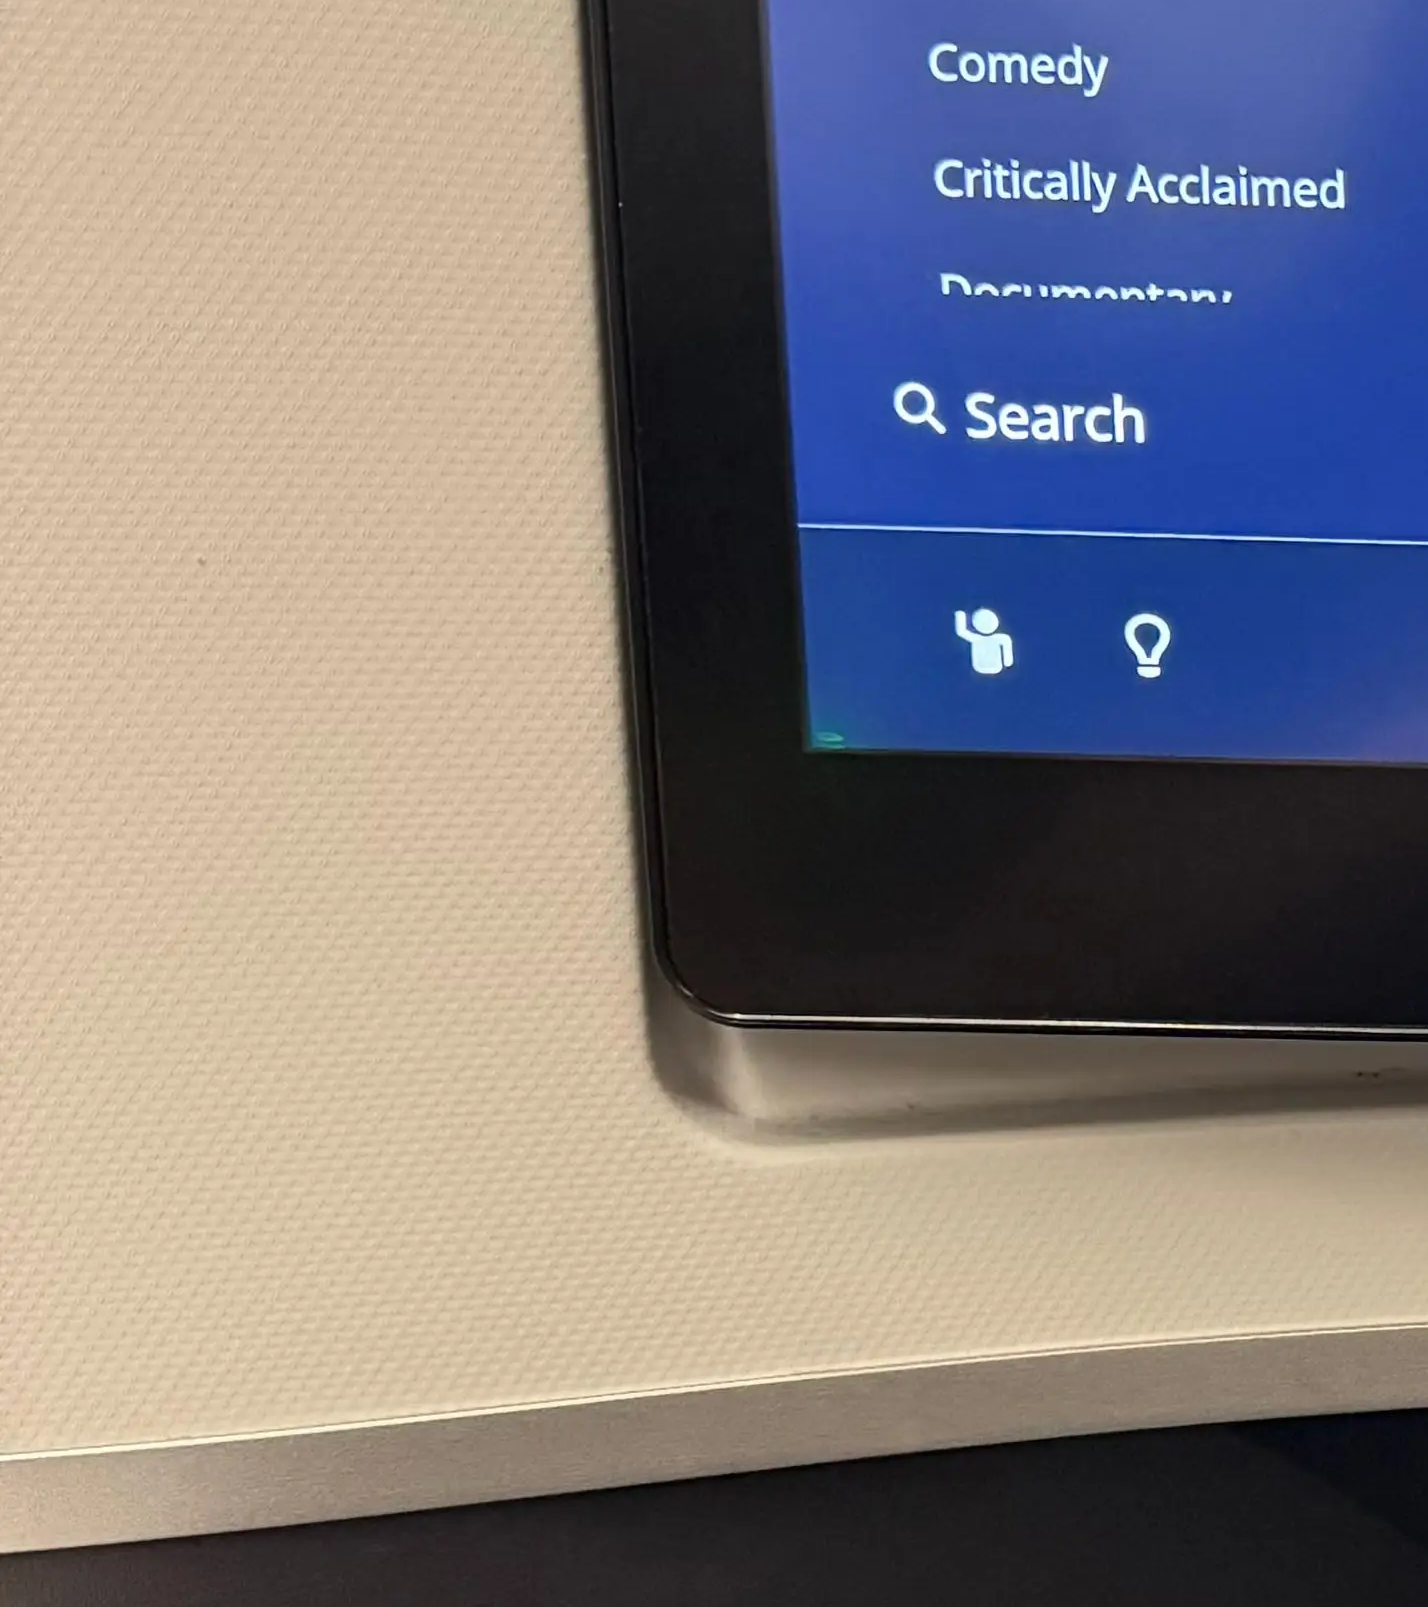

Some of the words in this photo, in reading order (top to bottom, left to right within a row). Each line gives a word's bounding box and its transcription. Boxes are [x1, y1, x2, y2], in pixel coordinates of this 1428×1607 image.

[929, 44, 1108, 97] Comedy
[935, 159, 1116, 213] Critically
[1127, 164, 1345, 208] Acclaimed
[966, 392, 1145, 443] Search
